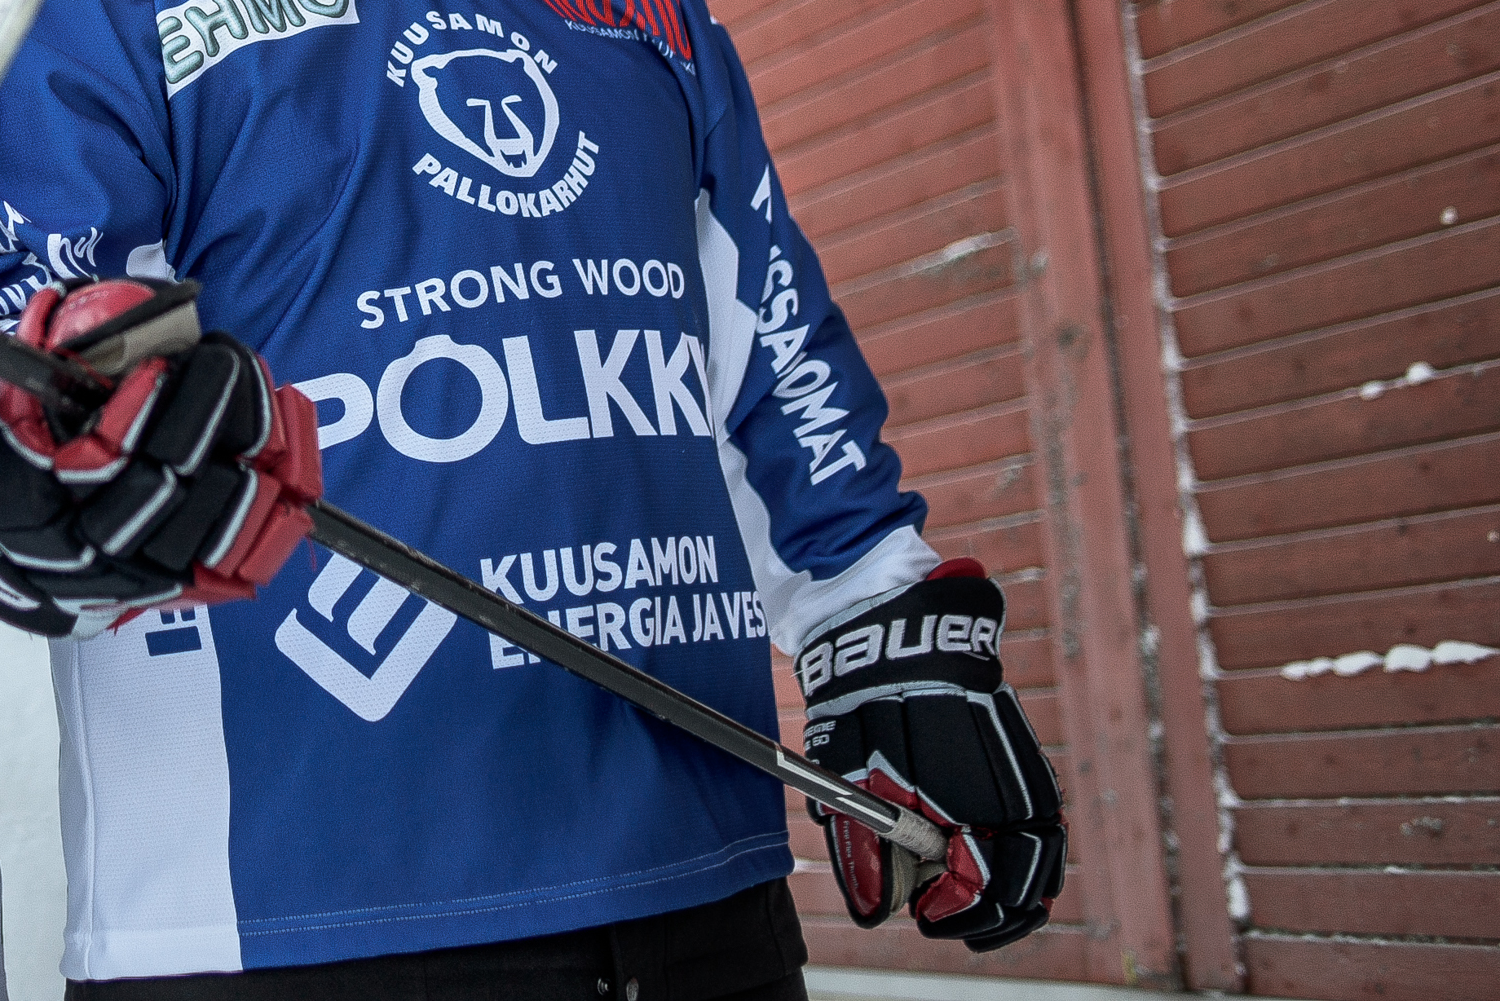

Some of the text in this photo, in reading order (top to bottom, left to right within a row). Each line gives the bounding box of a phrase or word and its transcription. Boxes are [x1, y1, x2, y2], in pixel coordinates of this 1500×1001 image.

[386, 10, 558, 88] KUUSAMON
[412, 130, 600, 218] PALLOKARHUT
[356, 257, 685, 330] STRONG WOOD
[479, 535, 719, 605] KUUSAMON
